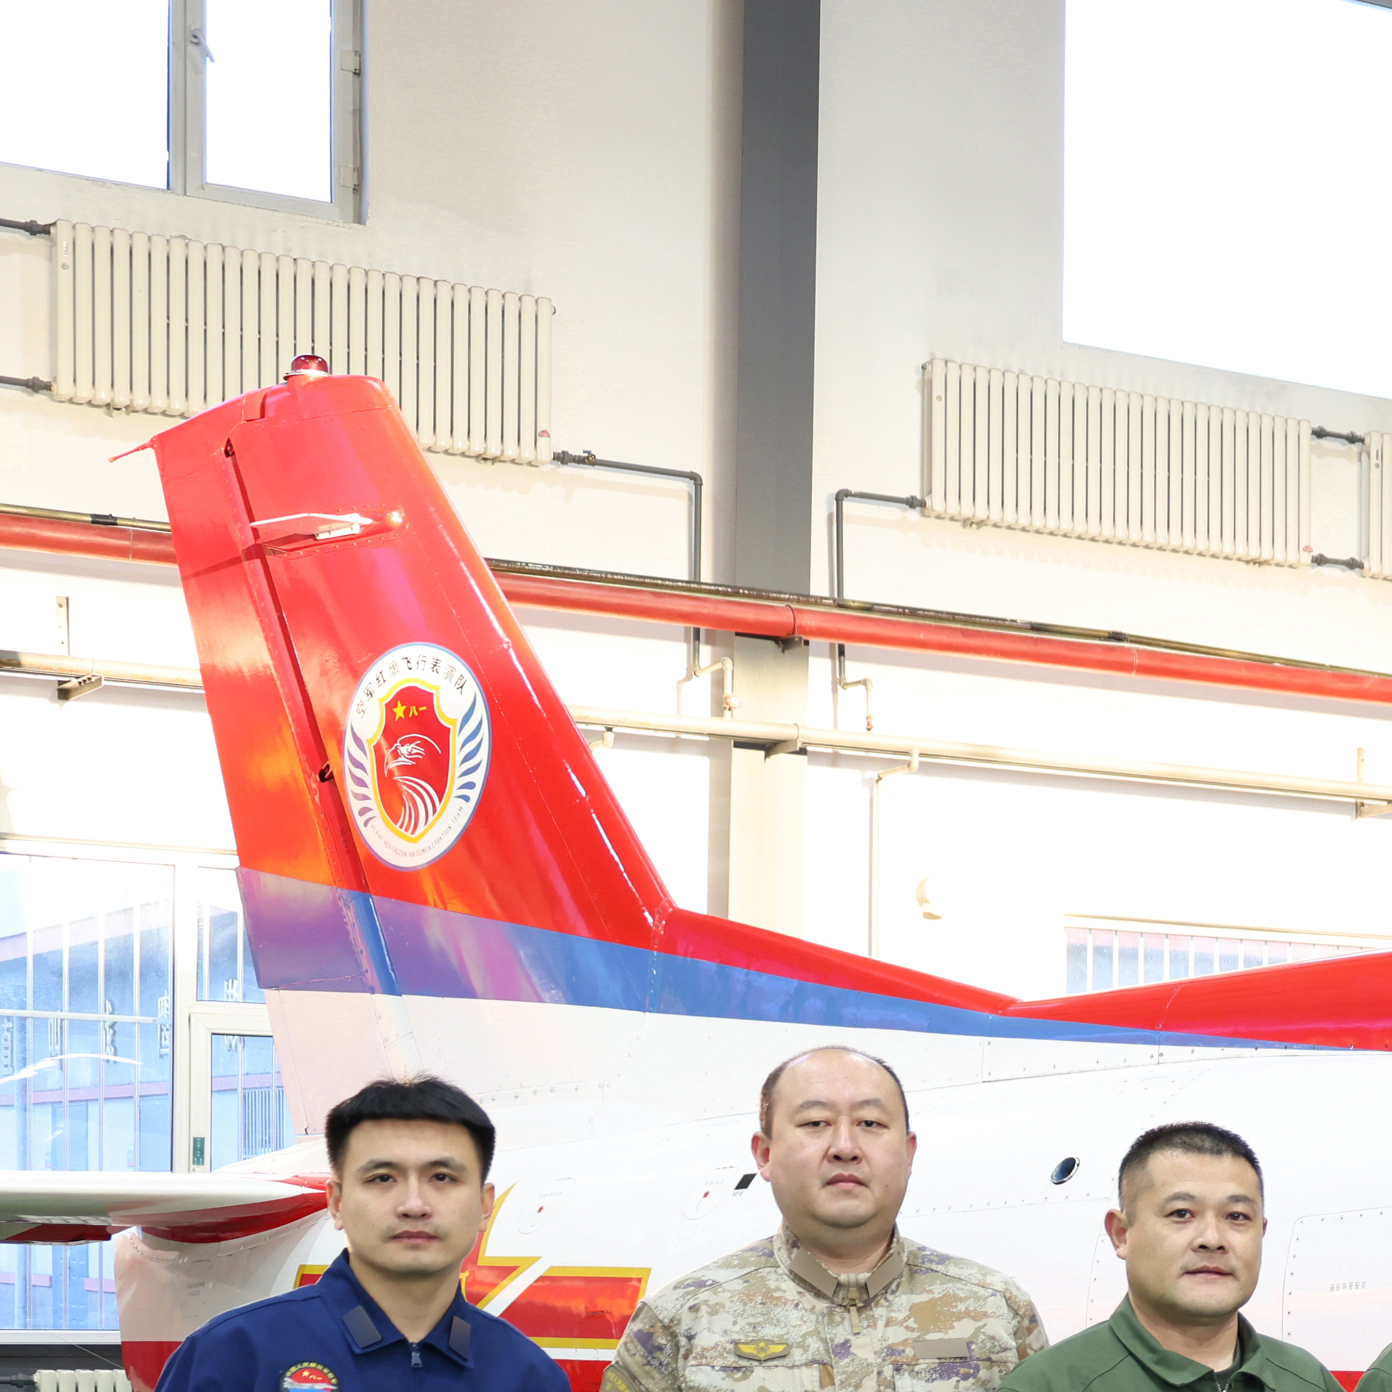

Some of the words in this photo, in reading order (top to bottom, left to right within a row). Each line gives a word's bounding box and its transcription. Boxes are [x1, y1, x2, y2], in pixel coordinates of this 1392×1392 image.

[355, 654, 468, 720] 空军红鹰飞行表演队
[408, 705, 428, 718] 八一
[451, 805, 464, 825] TEAM
